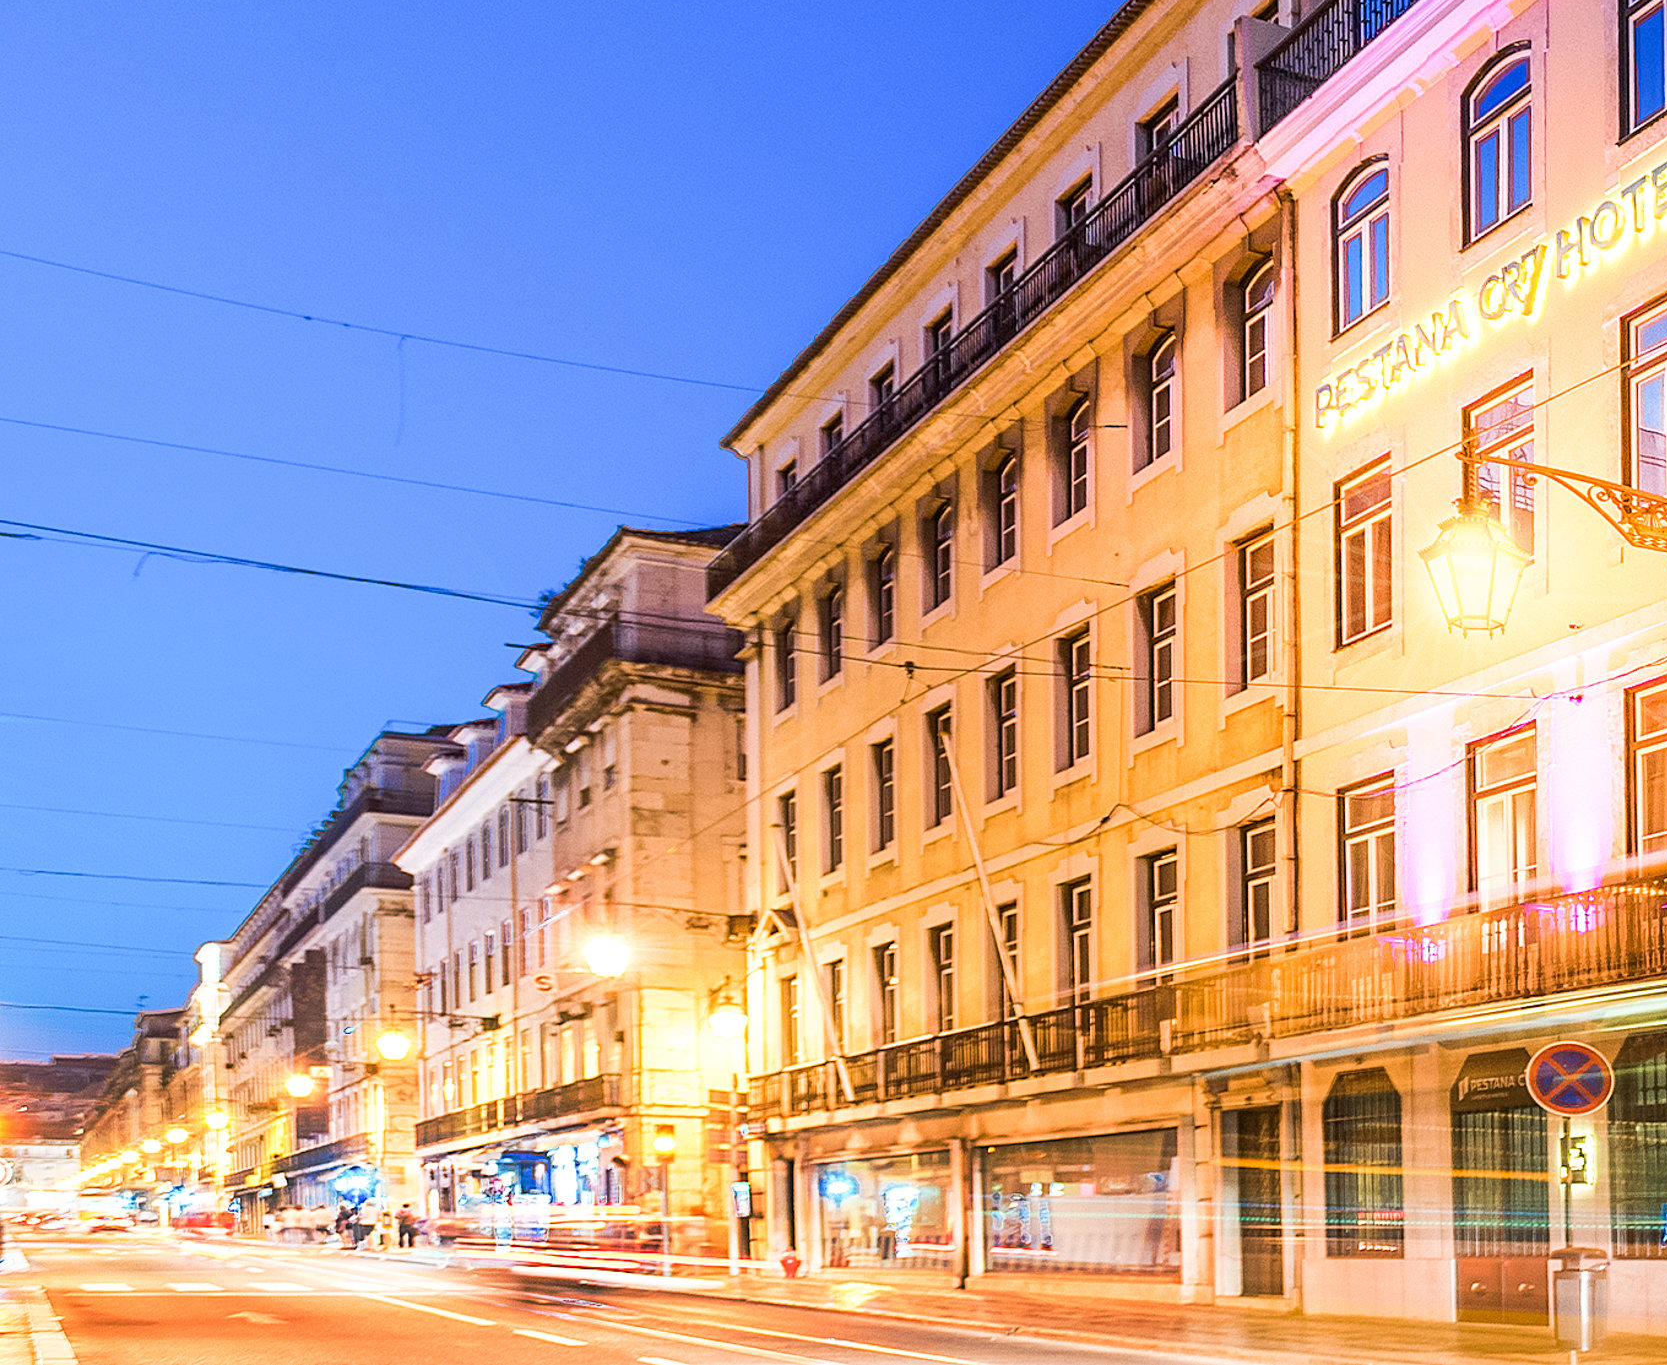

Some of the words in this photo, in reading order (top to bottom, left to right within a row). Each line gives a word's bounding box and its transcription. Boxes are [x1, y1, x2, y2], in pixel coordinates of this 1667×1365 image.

[1315, 300, 1471, 428] PESTANA
[1479, 244, 1548, 320] CR7
[1470, 1075, 1516, 1092] PESTANA
